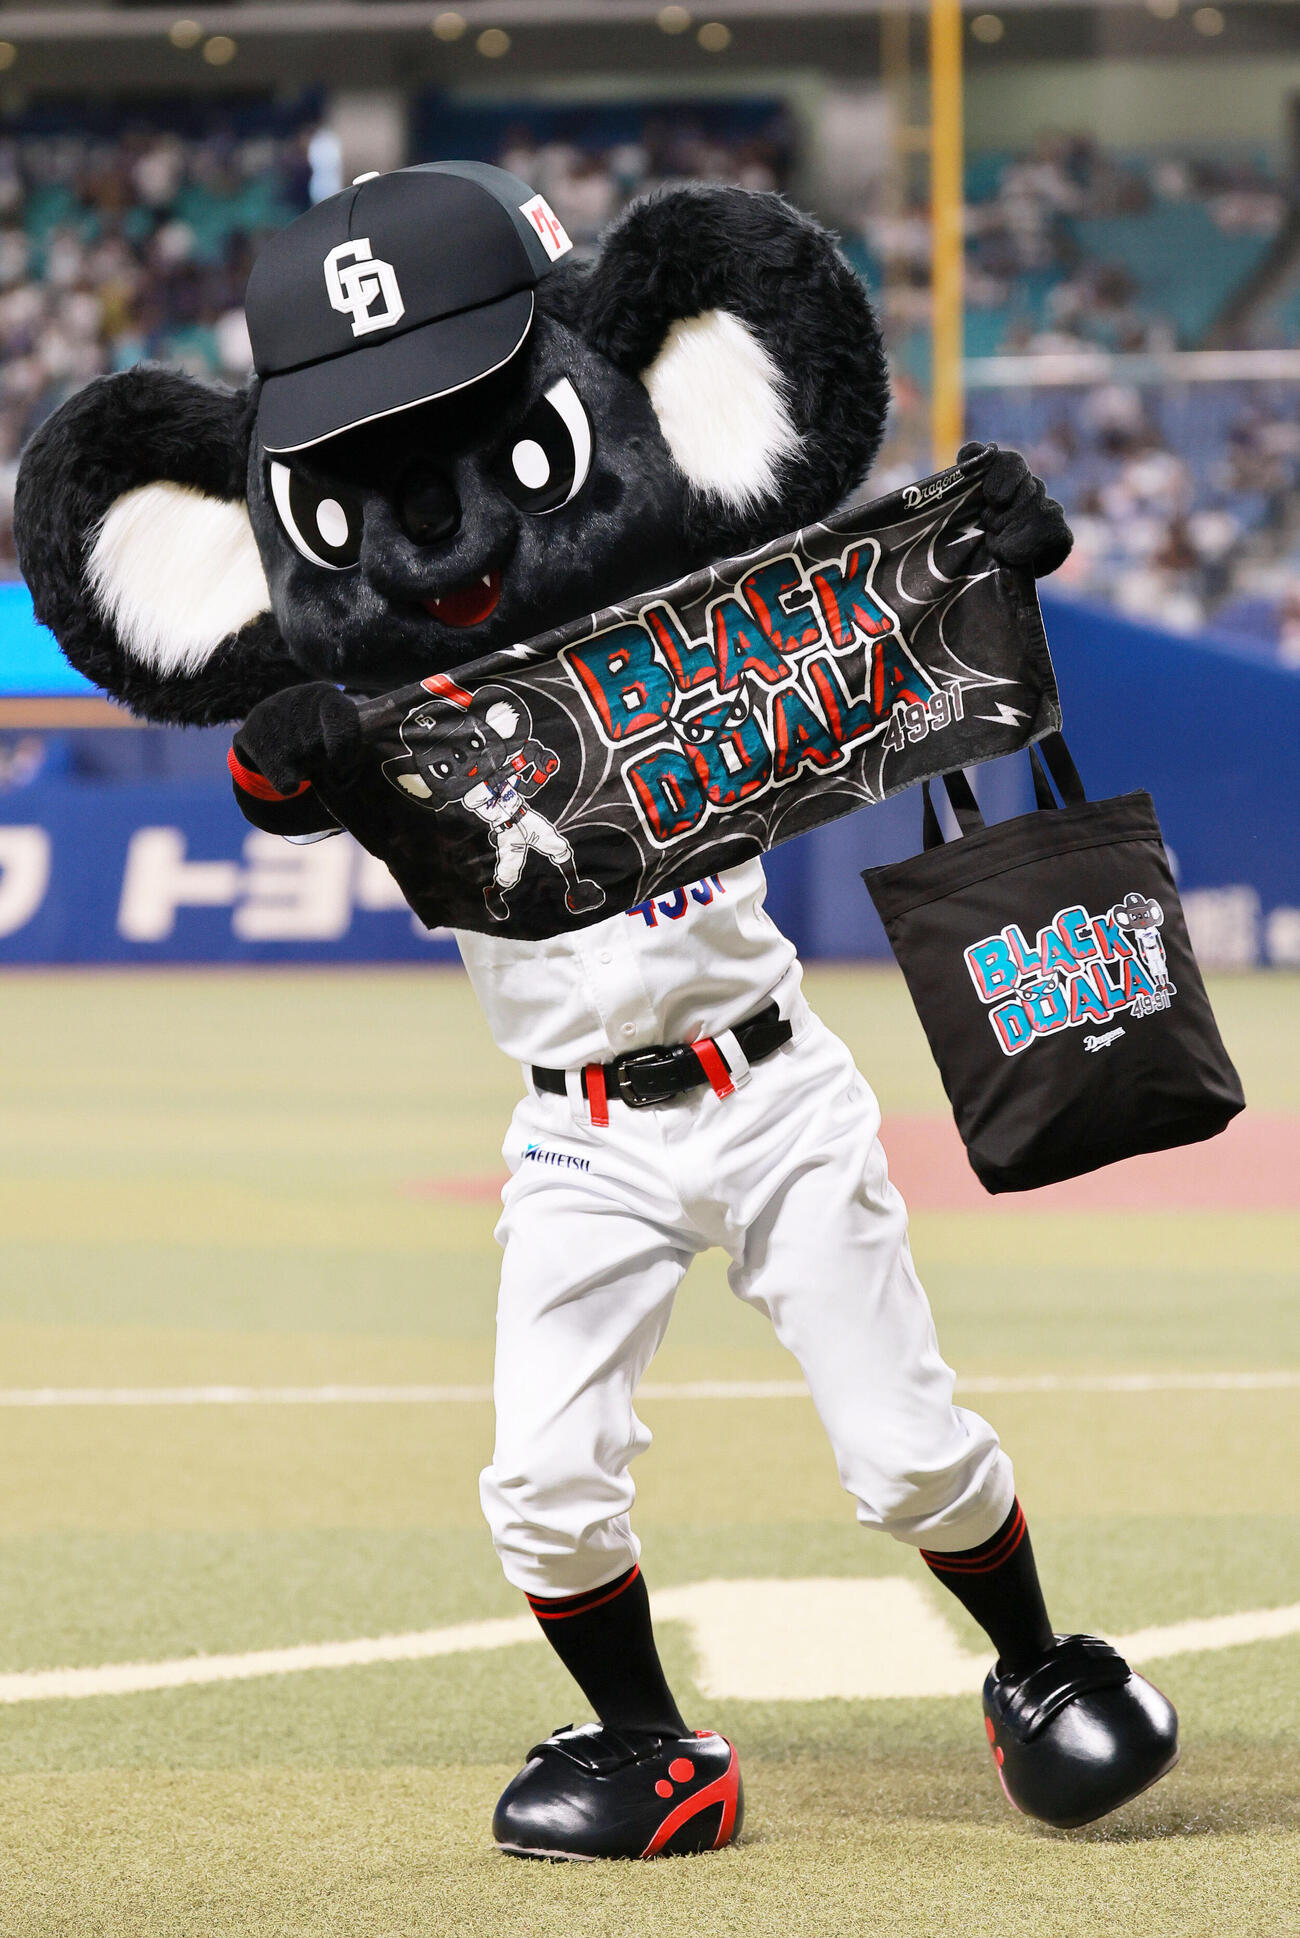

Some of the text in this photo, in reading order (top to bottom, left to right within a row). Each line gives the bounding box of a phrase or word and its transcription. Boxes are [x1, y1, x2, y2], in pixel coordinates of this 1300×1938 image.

[902, 469, 965, 510] Dragons
[560, 539, 900, 748] BLACK
[621, 634, 940, 850] DOALA
[881, 681, 965, 752] 4991
[963, 905, 1137, 1004] BLACK
[1130, 988, 1172, 1018] 4991
[988, 957, 1156, 1057] DOALA
